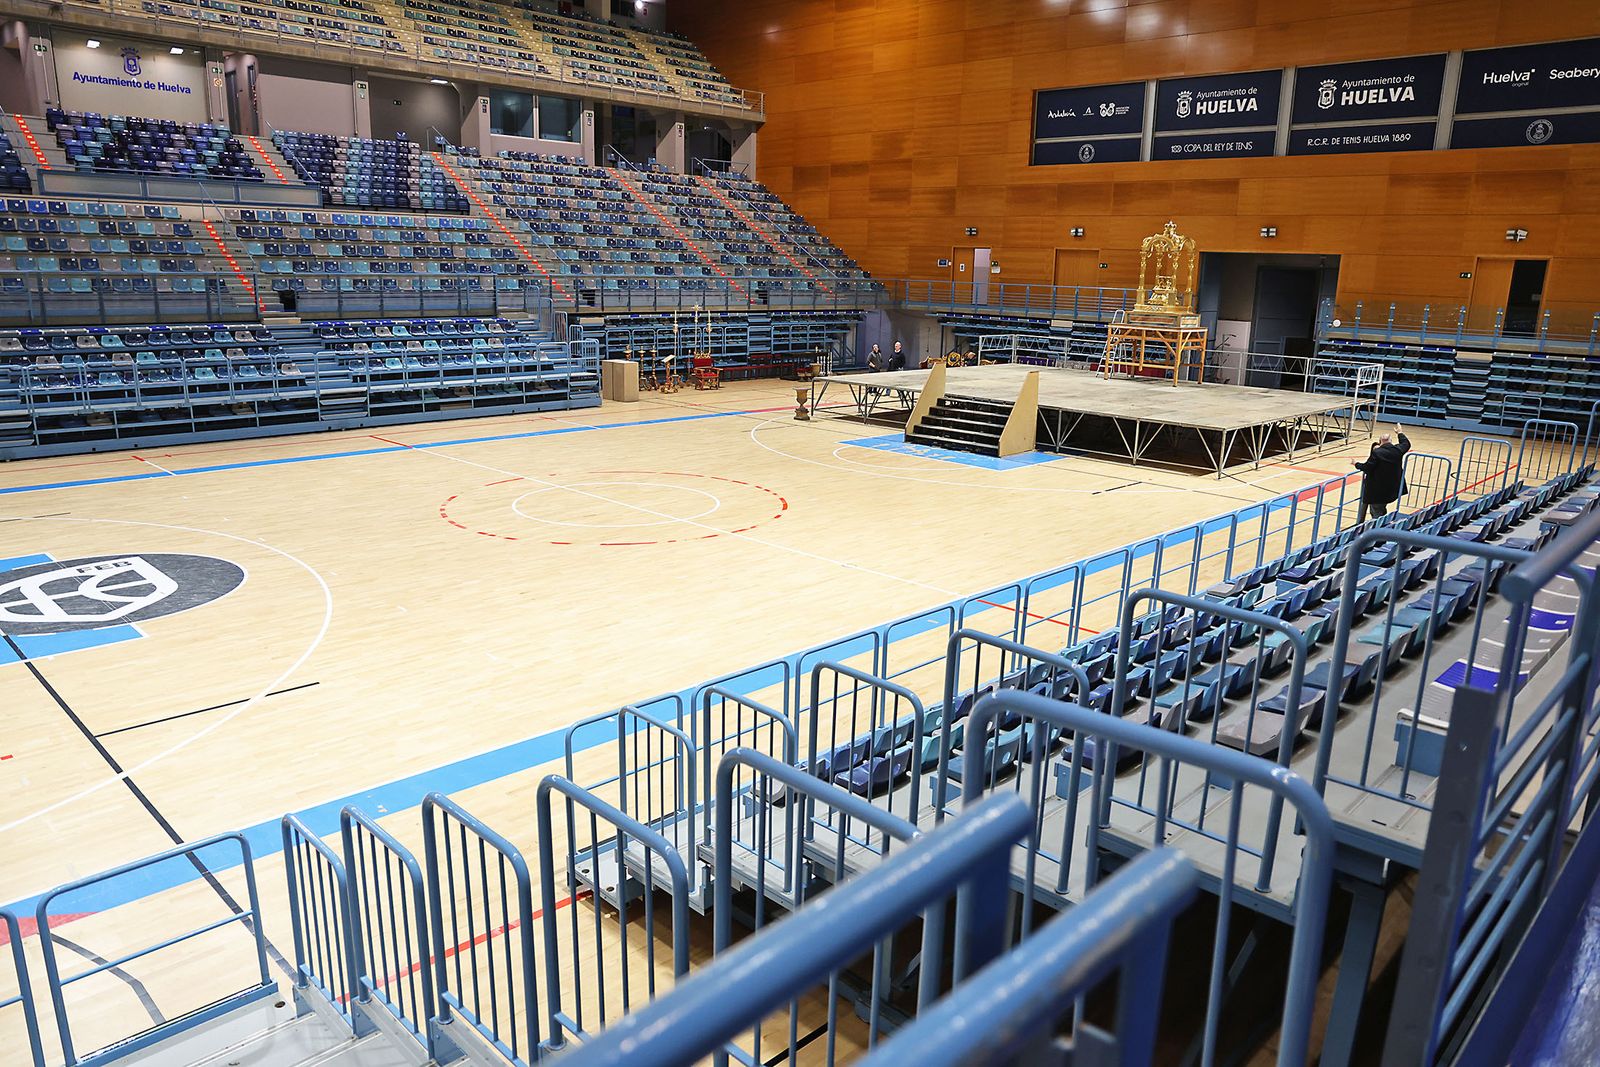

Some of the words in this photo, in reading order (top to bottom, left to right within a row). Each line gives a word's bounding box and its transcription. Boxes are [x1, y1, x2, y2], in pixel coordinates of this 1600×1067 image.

[1483, 70, 1531, 84] Huelva
[1549, 67, 1600, 80] Seabery
[72, 71, 142, 88] Ayuntamiento
[143, 79, 156, 90] de
[157, 80, 191, 95] Huelva
[1341, 75, 1402, 89] Ayuntamiento
[1403, 74, 1416, 83] de
[1196, 88, 1247, 100] Ayuntamiento
[1248, 86, 1258, 95] de
[1340, 86, 1416, 106] HUELVA
[1195, 97, 1258, 115] HUELVA
[1331, 137, 1341, 145] DE
[1343, 135, 1362, 145] TENIS
[1363, 134, 1390, 144] HUELVA
[1392, 133, 1412, 142] 1889
[1183, 143, 1203, 153] COPA
[1203, 143, 1213, 152] DEL
[1214, 142, 1226, 152] REY
[1226, 142, 1234, 151] DE
[1235, 141, 1253, 151] TENIS
